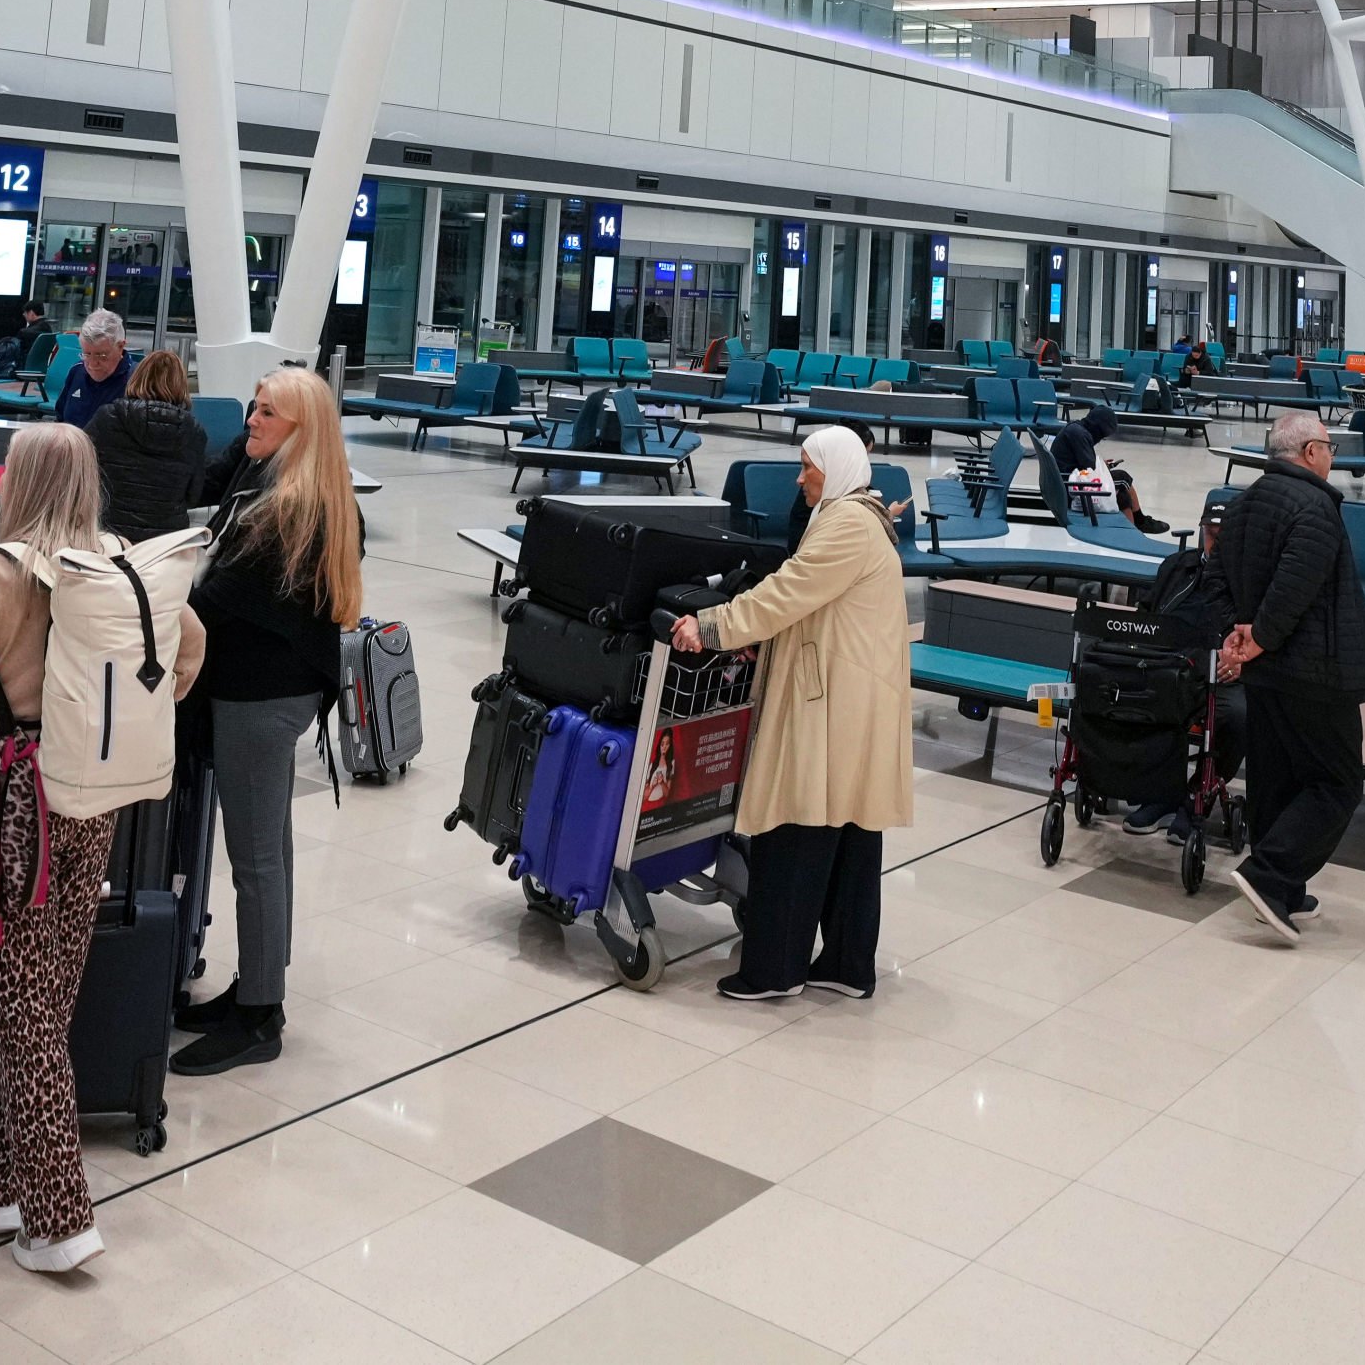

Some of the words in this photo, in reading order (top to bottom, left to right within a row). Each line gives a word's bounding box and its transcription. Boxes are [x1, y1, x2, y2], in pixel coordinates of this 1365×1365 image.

[0, 163, 31, 192] 12
[355, 194, 369, 218] 3
[599, 216, 615, 236] 14
[786, 232, 800, 251] 15
[934, 245, 946, 262] 16
[1052, 254, 1063, 270] 17
[1106, 619, 1157, 636] COSTWAY
